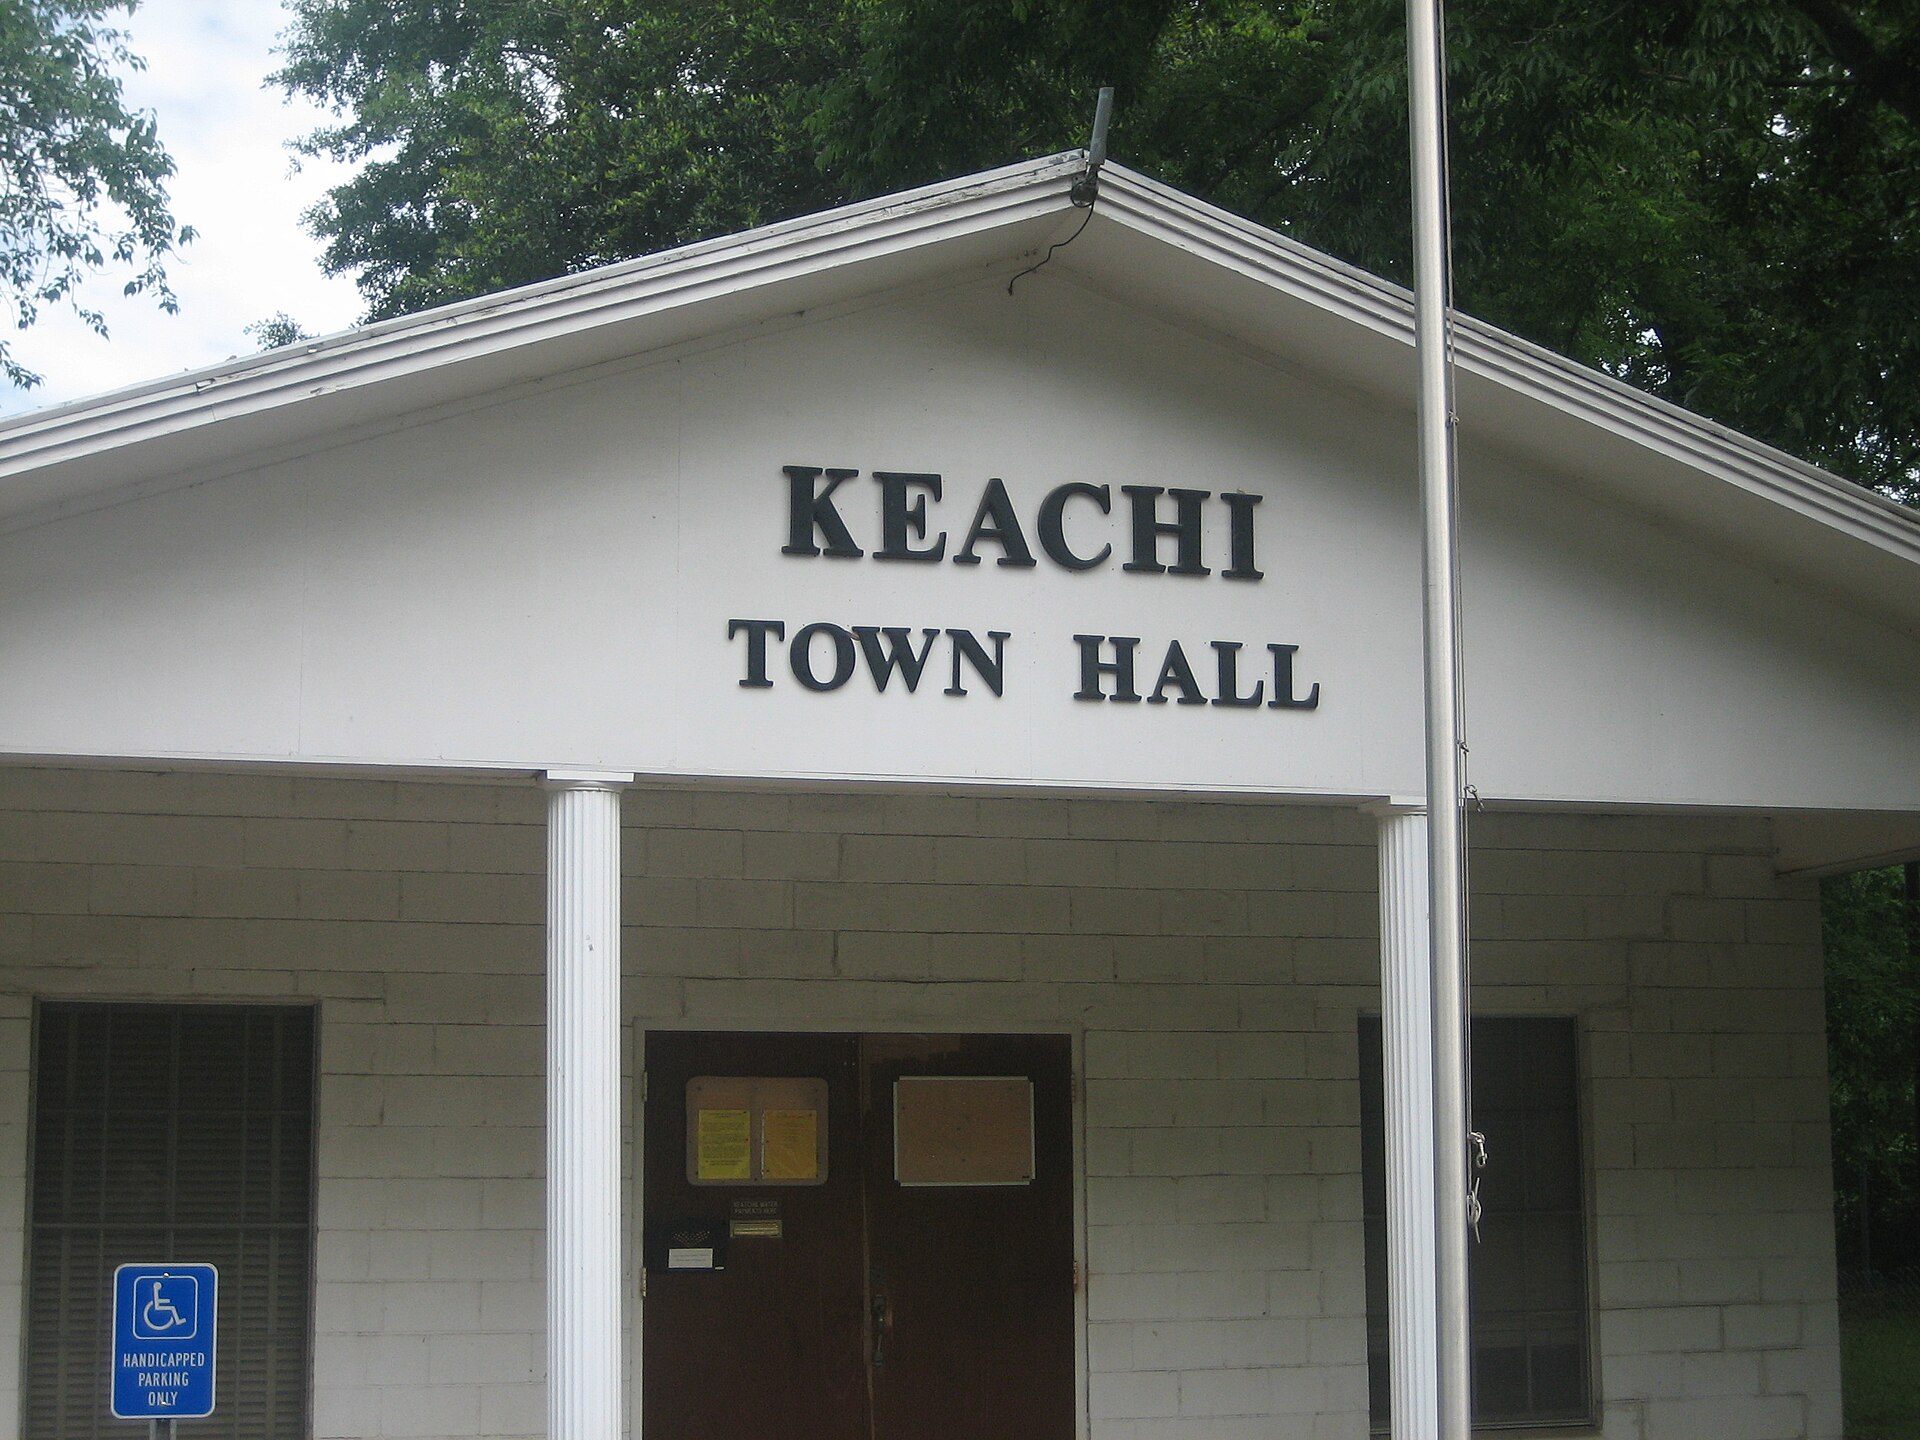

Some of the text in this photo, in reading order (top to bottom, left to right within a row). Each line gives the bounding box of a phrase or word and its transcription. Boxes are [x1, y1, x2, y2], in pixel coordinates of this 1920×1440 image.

[781, 465, 1265, 581] KEACHI
[728, 619, 1320, 711] TOWN HALL
[123, 1352, 205, 1367] HANDICAPPED
[138, 1372, 189, 1387] PARKING
[148, 1391, 178, 1407] ONLY
